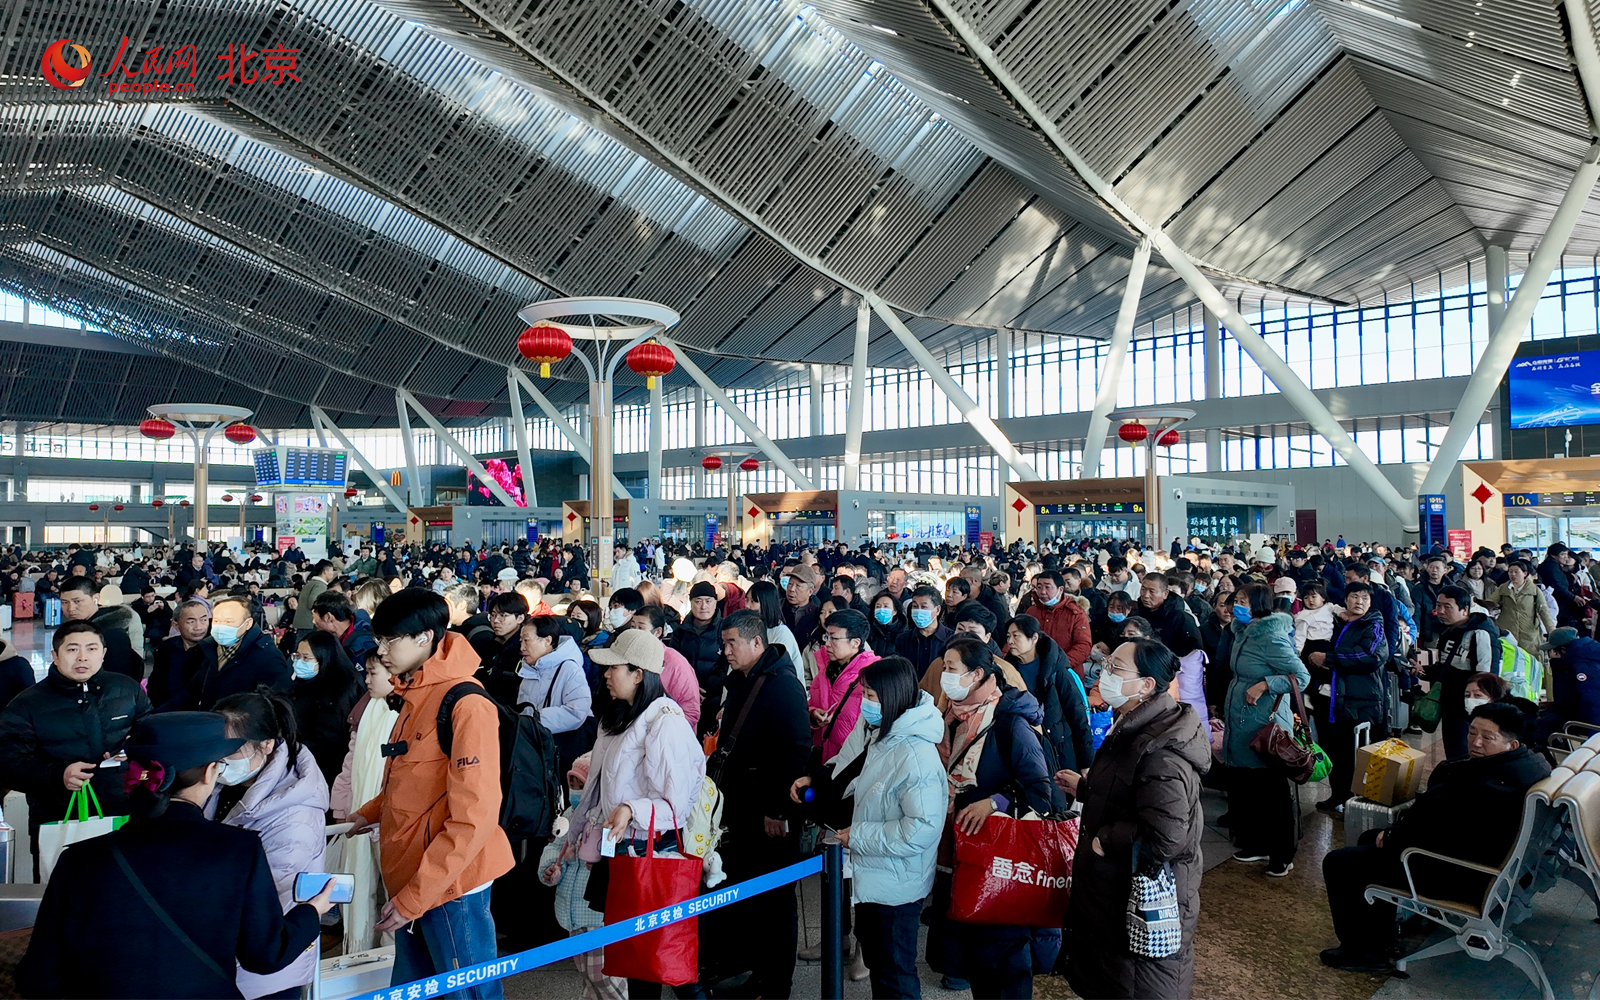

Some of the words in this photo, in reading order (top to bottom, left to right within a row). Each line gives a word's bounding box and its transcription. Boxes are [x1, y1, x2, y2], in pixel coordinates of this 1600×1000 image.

[1510, 495, 1531, 505] 10A
[1041, 506, 1050, 514] 8A
[1133, 504, 1143, 512] 9A
[457, 756, 480, 768] FILA
[634, 906, 683, 932] 北京安检
[688, 888, 739, 914] SECURITY
[447, 958, 519, 989] SECURITY
